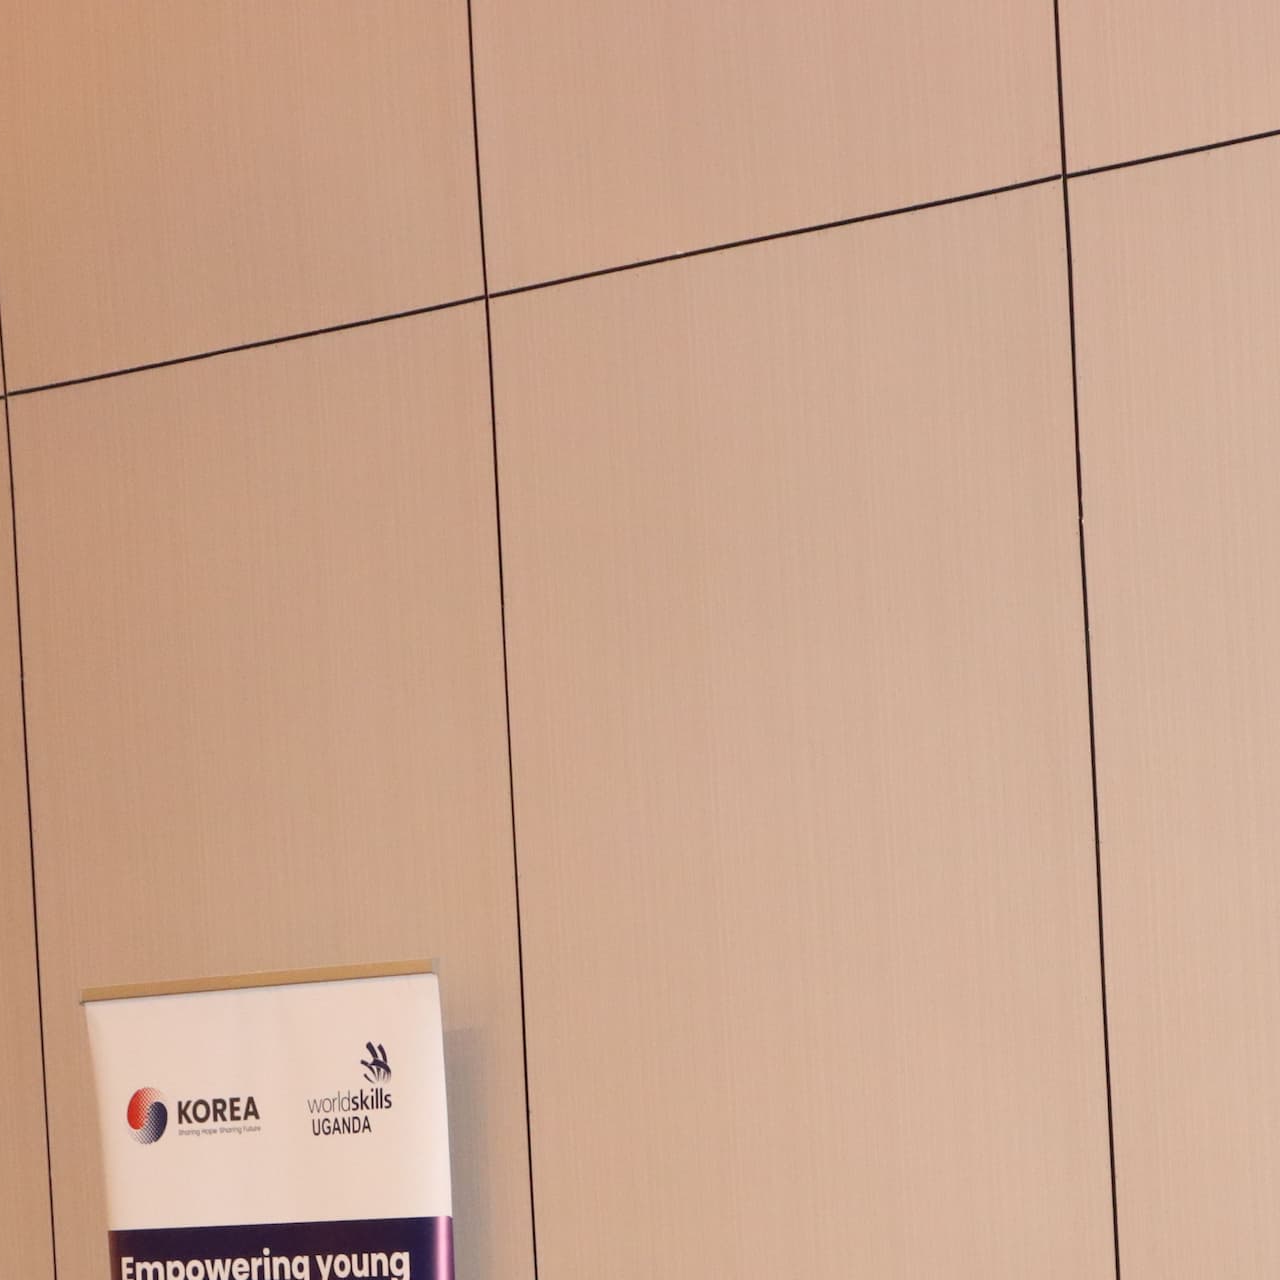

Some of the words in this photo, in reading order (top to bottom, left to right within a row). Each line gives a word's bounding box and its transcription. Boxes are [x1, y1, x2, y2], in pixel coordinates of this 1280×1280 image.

[177, 1096, 260, 1124] KOREA
[307, 1088, 392, 1114] worldskills
[312, 1115, 372, 1136] UGANDA
